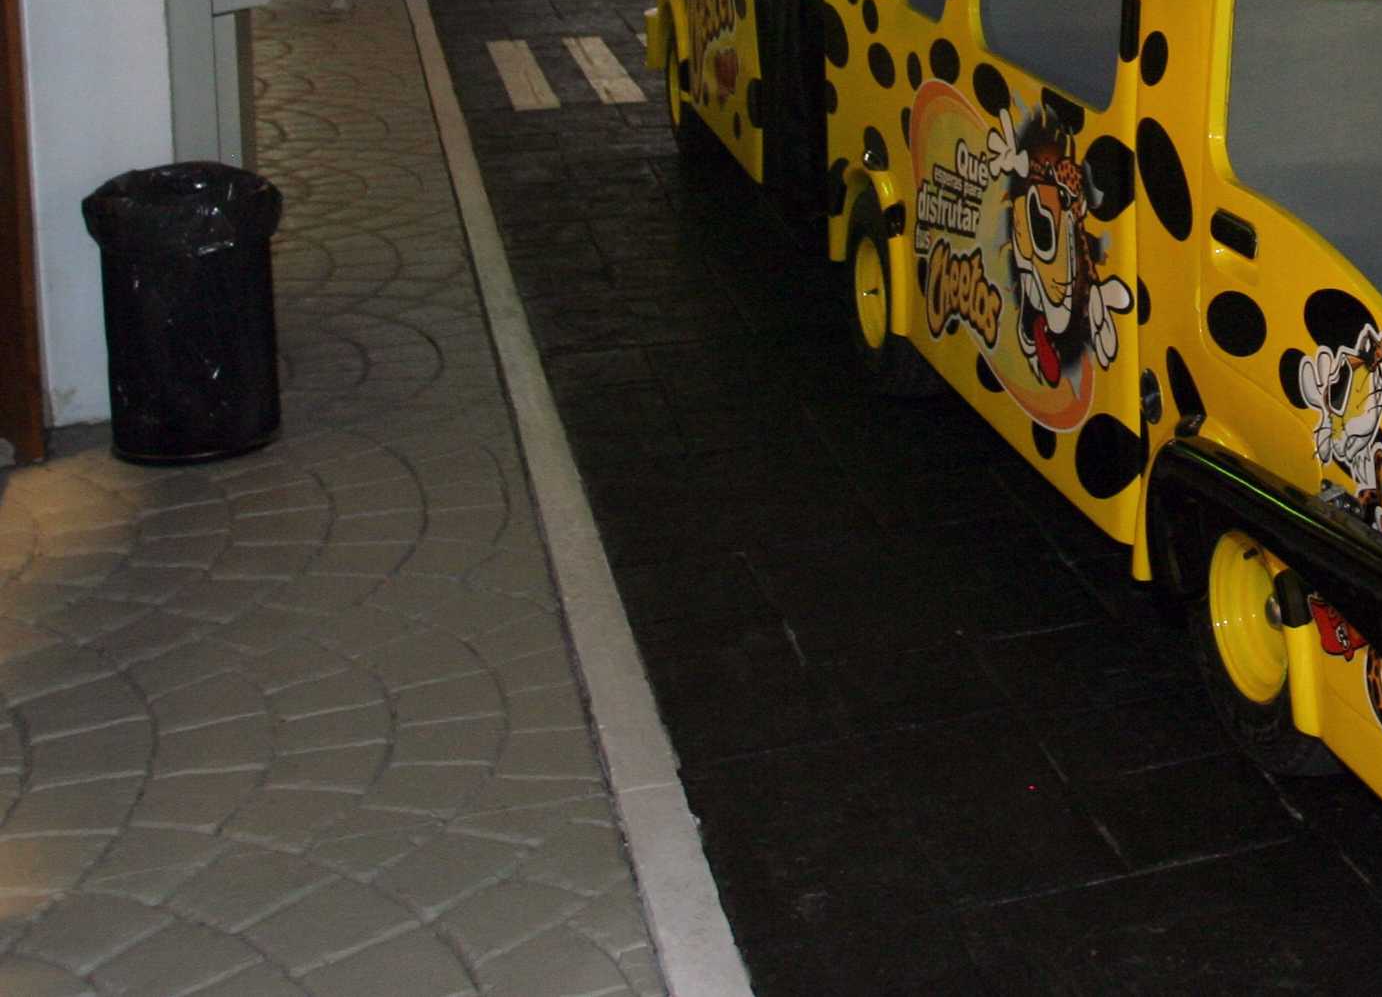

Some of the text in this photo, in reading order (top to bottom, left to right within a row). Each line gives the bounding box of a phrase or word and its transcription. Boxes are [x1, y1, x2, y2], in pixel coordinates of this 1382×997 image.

[934, 167, 983, 199] esperas para
[957, 140, 988, 186] Qué
[918, 182, 980, 234] disfrutar
[916, 223, 930, 249] tus
[928, 239, 1002, 348] Cheetos
